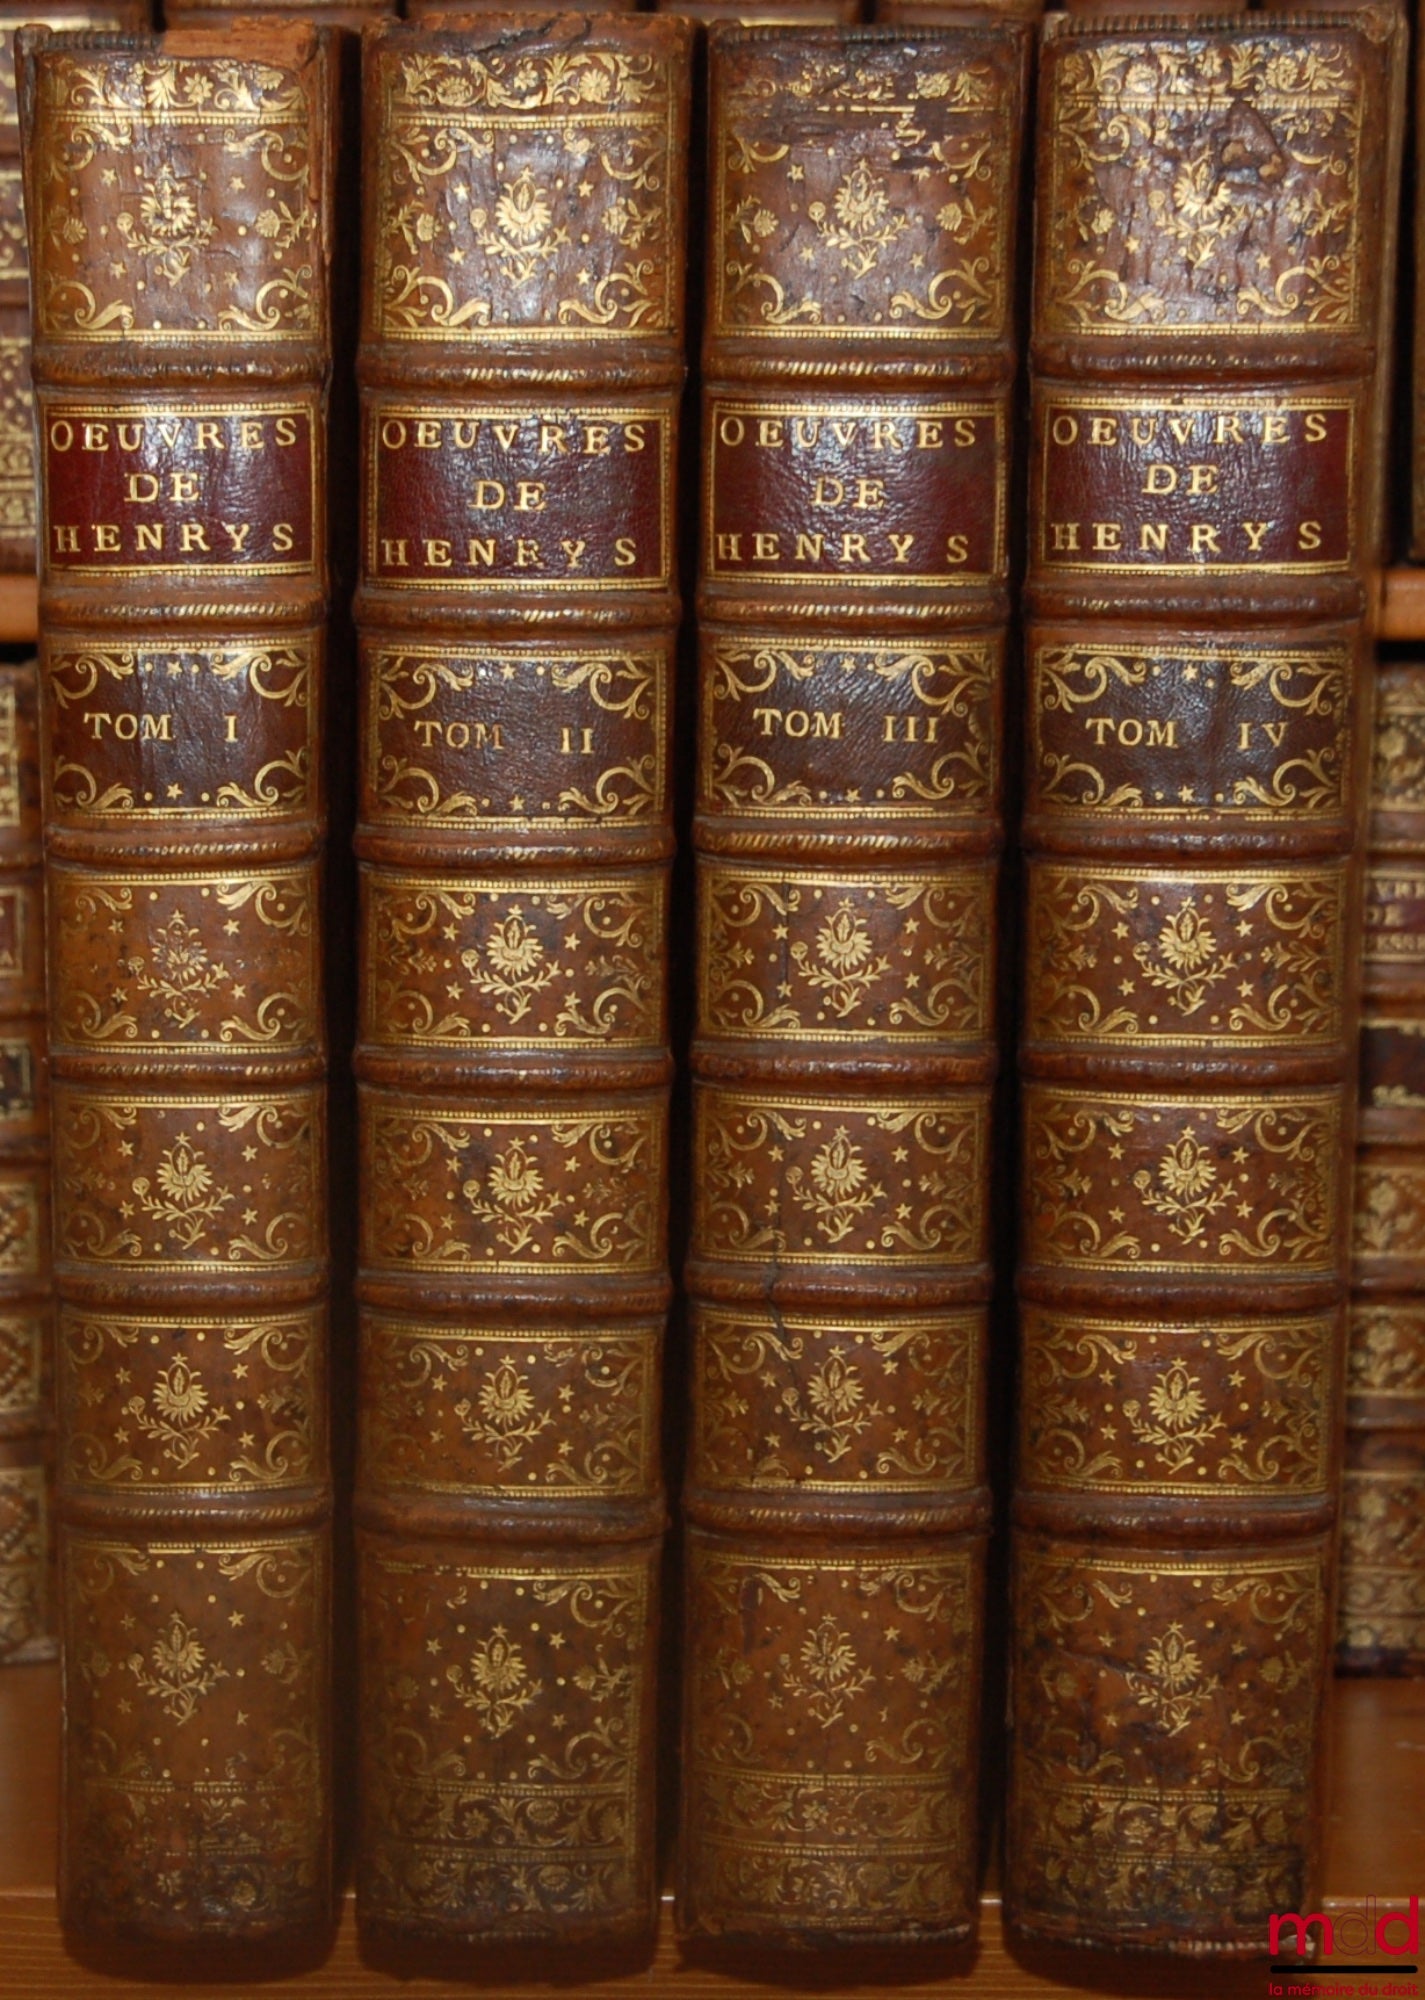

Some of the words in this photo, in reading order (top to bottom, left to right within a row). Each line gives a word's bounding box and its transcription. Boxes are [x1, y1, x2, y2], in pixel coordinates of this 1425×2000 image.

[51, 418, 297, 452] OEUVRES
[382, 419, 646, 455] OEUVRES
[720, 416, 976, 449] OEUVRES
[1053, 413, 1328, 446] OEUVRES
[124, 472, 200, 503] DE
[468, 479, 546, 512] DE
[811, 475, 885, 509] DE
[1142, 463, 1220, 495] DE
[53, 523, 294, 553] HENRYS
[381, 537, 637, 568] HENRYS
[716, 532, 969, 563] HENRYS
[1051, 520, 1323, 554] HENRYS
[84, 712, 173, 741] TOM
[223, 714, 239, 743] I
[414, 720, 504, 750] TOM
[560, 727, 594, 754] II
[753, 708, 843, 740] TOM
[883, 714, 939, 743] III
[1085, 718, 1179, 748] TOM
[1237, 722, 1289, 750] IV
